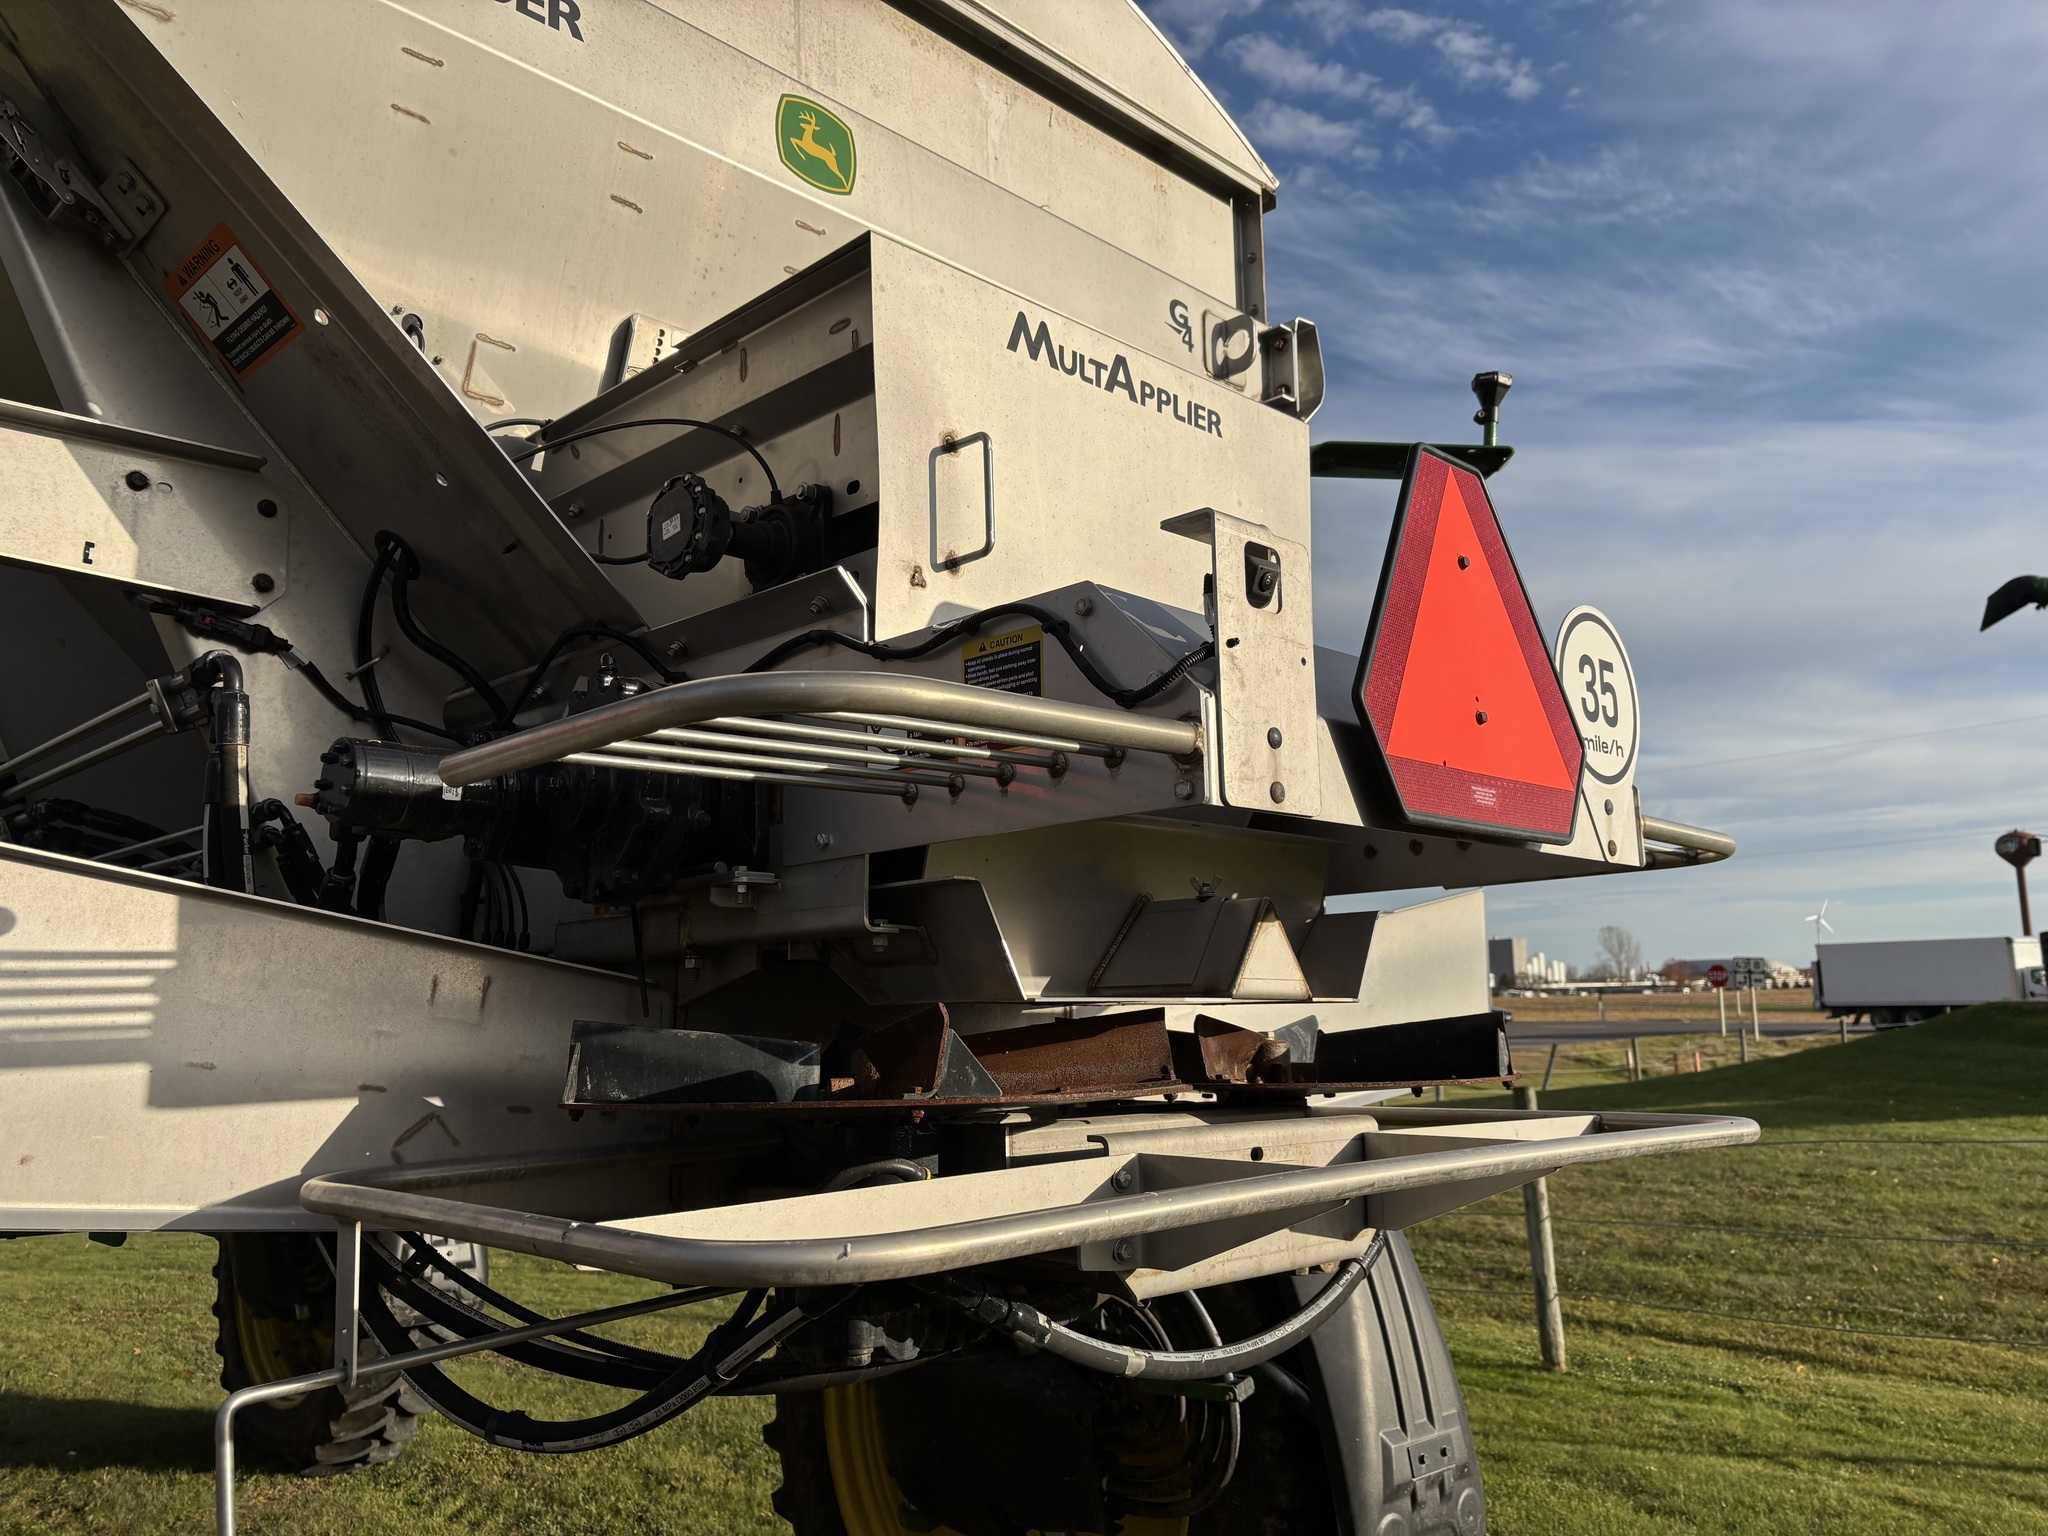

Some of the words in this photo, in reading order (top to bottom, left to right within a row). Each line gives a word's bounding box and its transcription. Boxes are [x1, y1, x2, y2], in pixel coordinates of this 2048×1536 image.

[182, 239, 220, 279] WARNING
[234, 288, 243, 297] KEEP
[240, 295, 249, 304] AWAY
[225, 329, 241, 344] FLYING
[237, 318, 253, 334] DEBRIS
[249, 304, 268, 323] HAZARD!
[230, 344, 243, 357] prevent
[240, 335, 253, 348] serious
[250, 328, 262, 340] injury
[232, 356, 242, 367] STAY
[248, 337, 265, 353] OBJECTS
[261, 331, 271, 342] CAN
[268, 327, 276, 336] BE
[990, 634, 1023, 650] CAUTION
[1579, 654, 1618, 728] 35
[1583, 735, 1624, 757] mile/h
[1709, 970, 1728, 981] STOP
[437, 1292, 452, 1304] MPa
[653, 1408, 663, 1419] 21
[661, 1400, 677, 1414] MPa
[675, 1389, 693, 1406] (3000
[692, 1378, 707, 1395] PSI)
